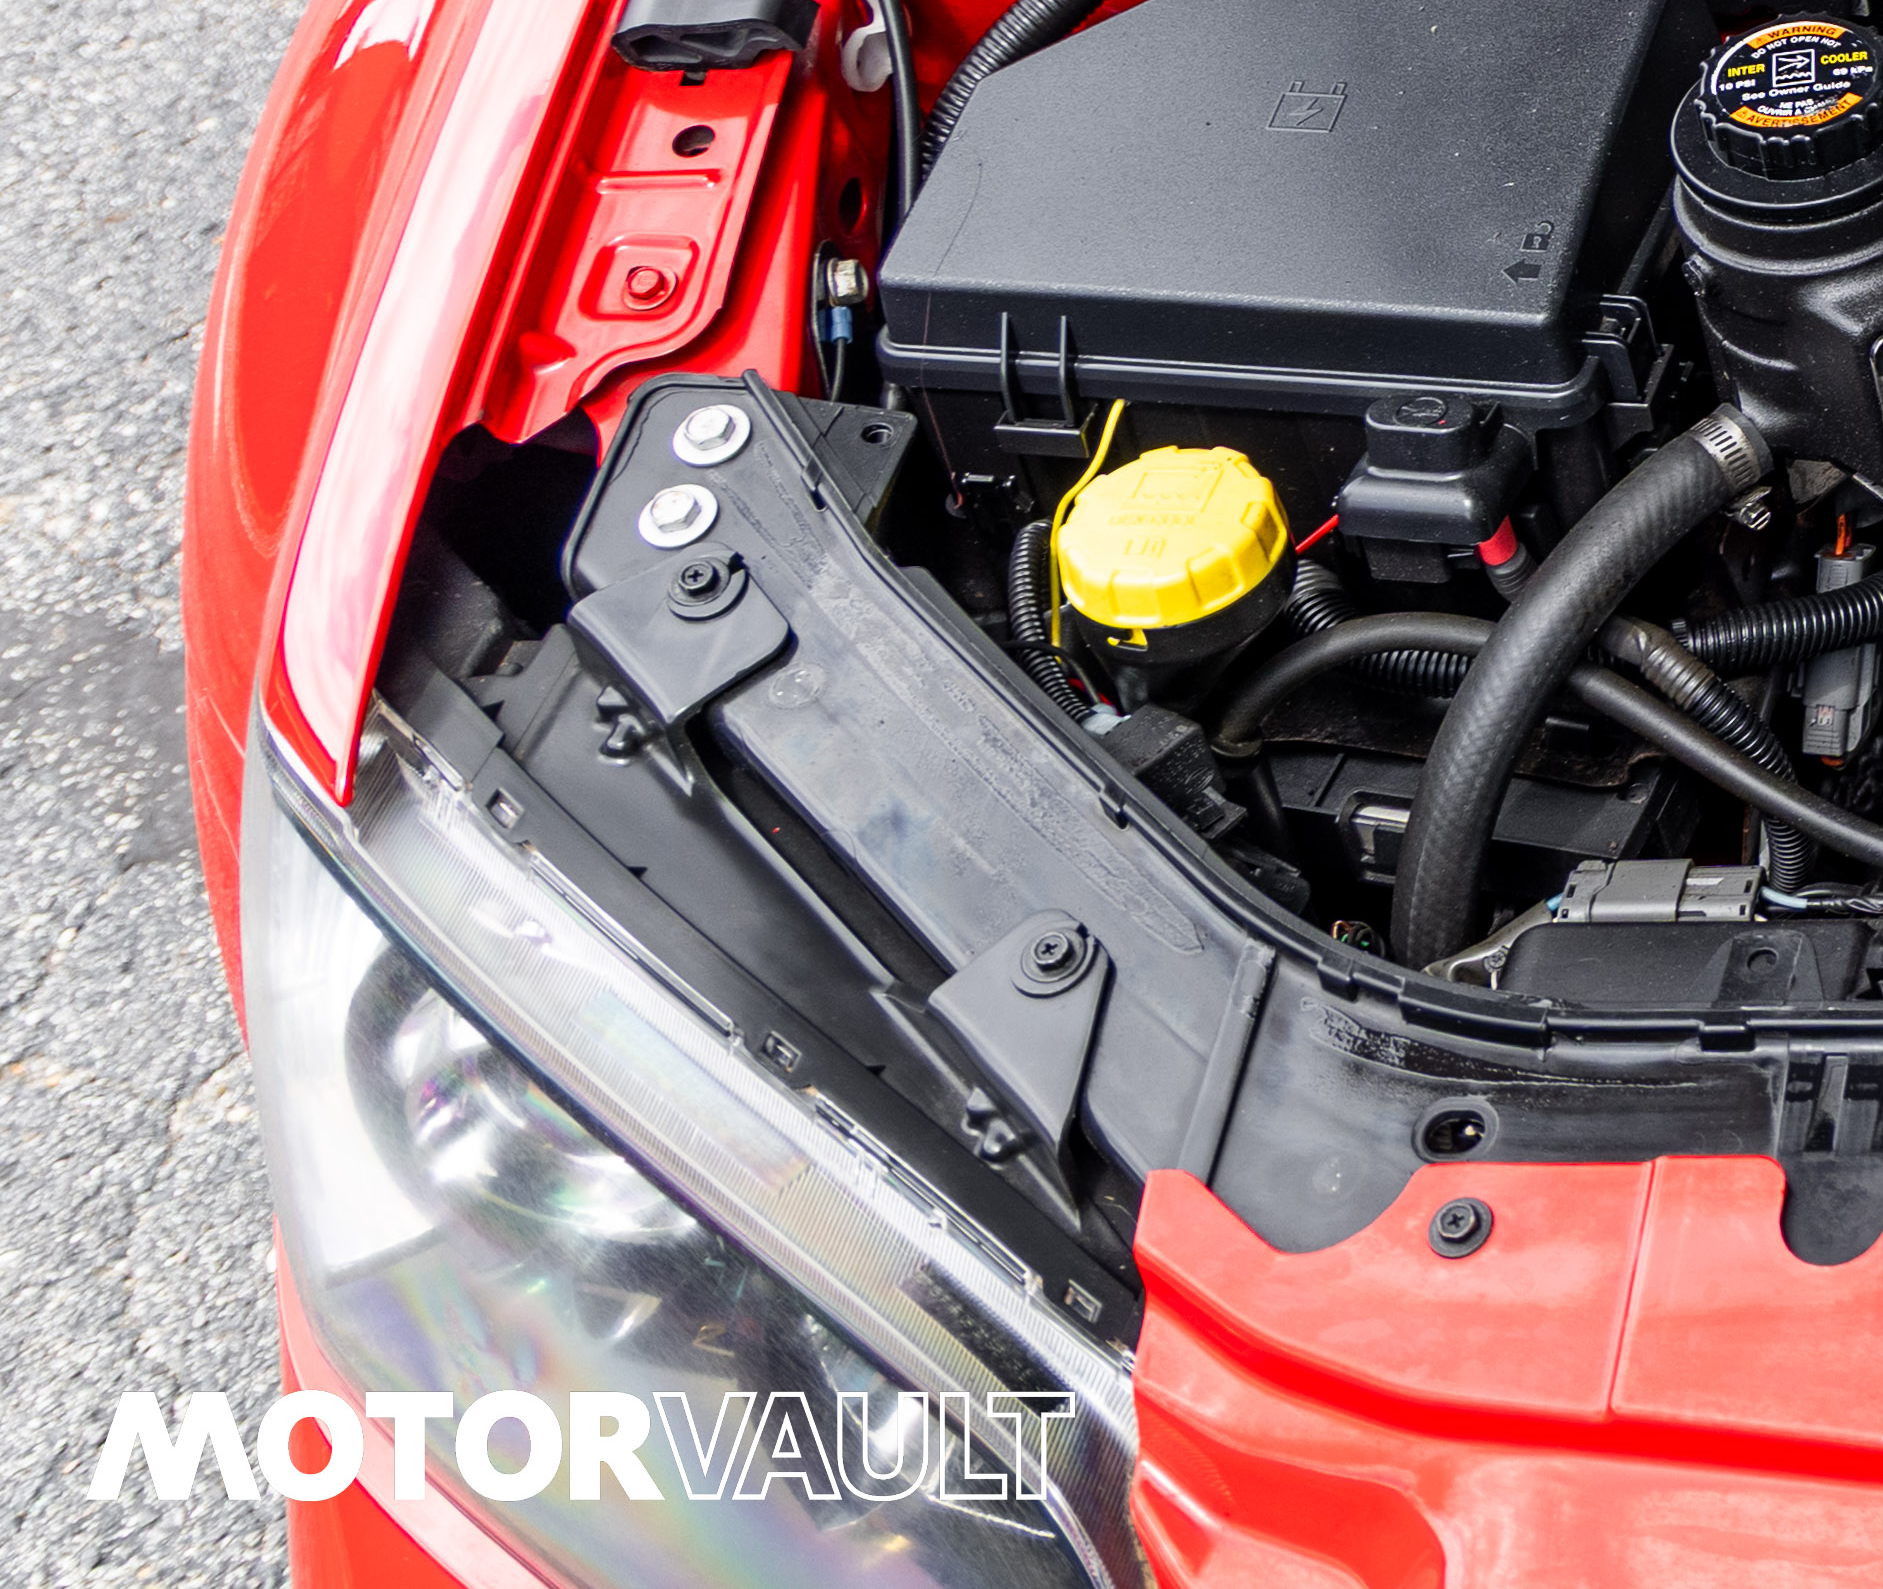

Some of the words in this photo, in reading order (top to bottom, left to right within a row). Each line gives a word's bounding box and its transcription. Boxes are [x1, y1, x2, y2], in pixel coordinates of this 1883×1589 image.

[1767, 25, 1837, 38] WARNING
[1751, 47, 1767, 59] DO
[1768, 38, 1788, 51] NOT
[1790, 35, 1819, 44] OPEN
[1820, 37, 1842, 49] HOT
[1820, 51, 1868, 65] COOLER
[1728, 63, 1766, 78] INTER
[1850, 65, 1874, 75] kPa
[1719, 83, 1733, 91] 10
[1735, 79, 1756, 89] PSI
[1741, 91, 1766, 102] See
[1768, 86, 1810, 98] Owner
[1812, 80, 1851, 92] Guide
[1795, 98, 1815, 108] PAS
[1747, 99, 1852, 128] AVERTISSEMENT
